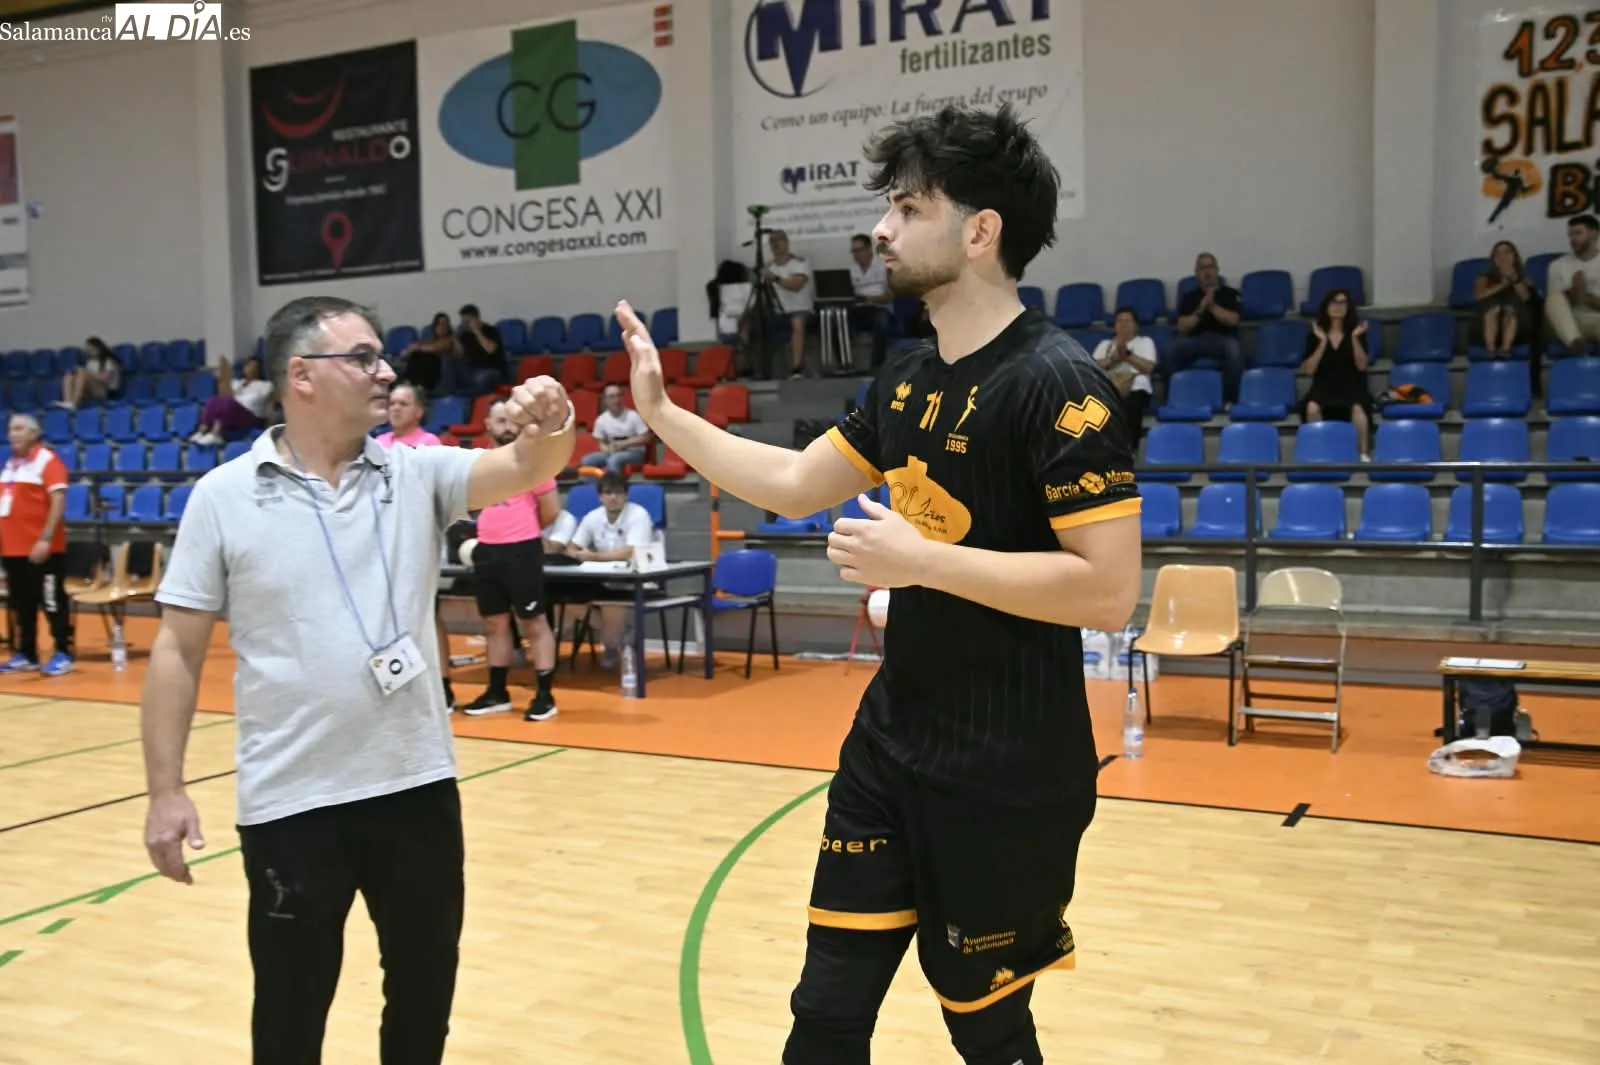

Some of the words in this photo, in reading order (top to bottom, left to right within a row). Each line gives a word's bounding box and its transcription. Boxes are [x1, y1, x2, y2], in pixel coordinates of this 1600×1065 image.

[900, 33, 1052, 74] fertilizantes
[497, 72, 596, 138] CG
[761, 112, 804, 132] Como
[809, 111, 829, 126] un
[890, 98, 911, 116] La
[442, 196, 604, 240] CONGESA
[615, 187, 662, 223] XXI
[460, 230, 647, 259] www.congesaxxi.com
[945, 439, 968, 454] 1995
[1045, 481, 1080, 501] García
